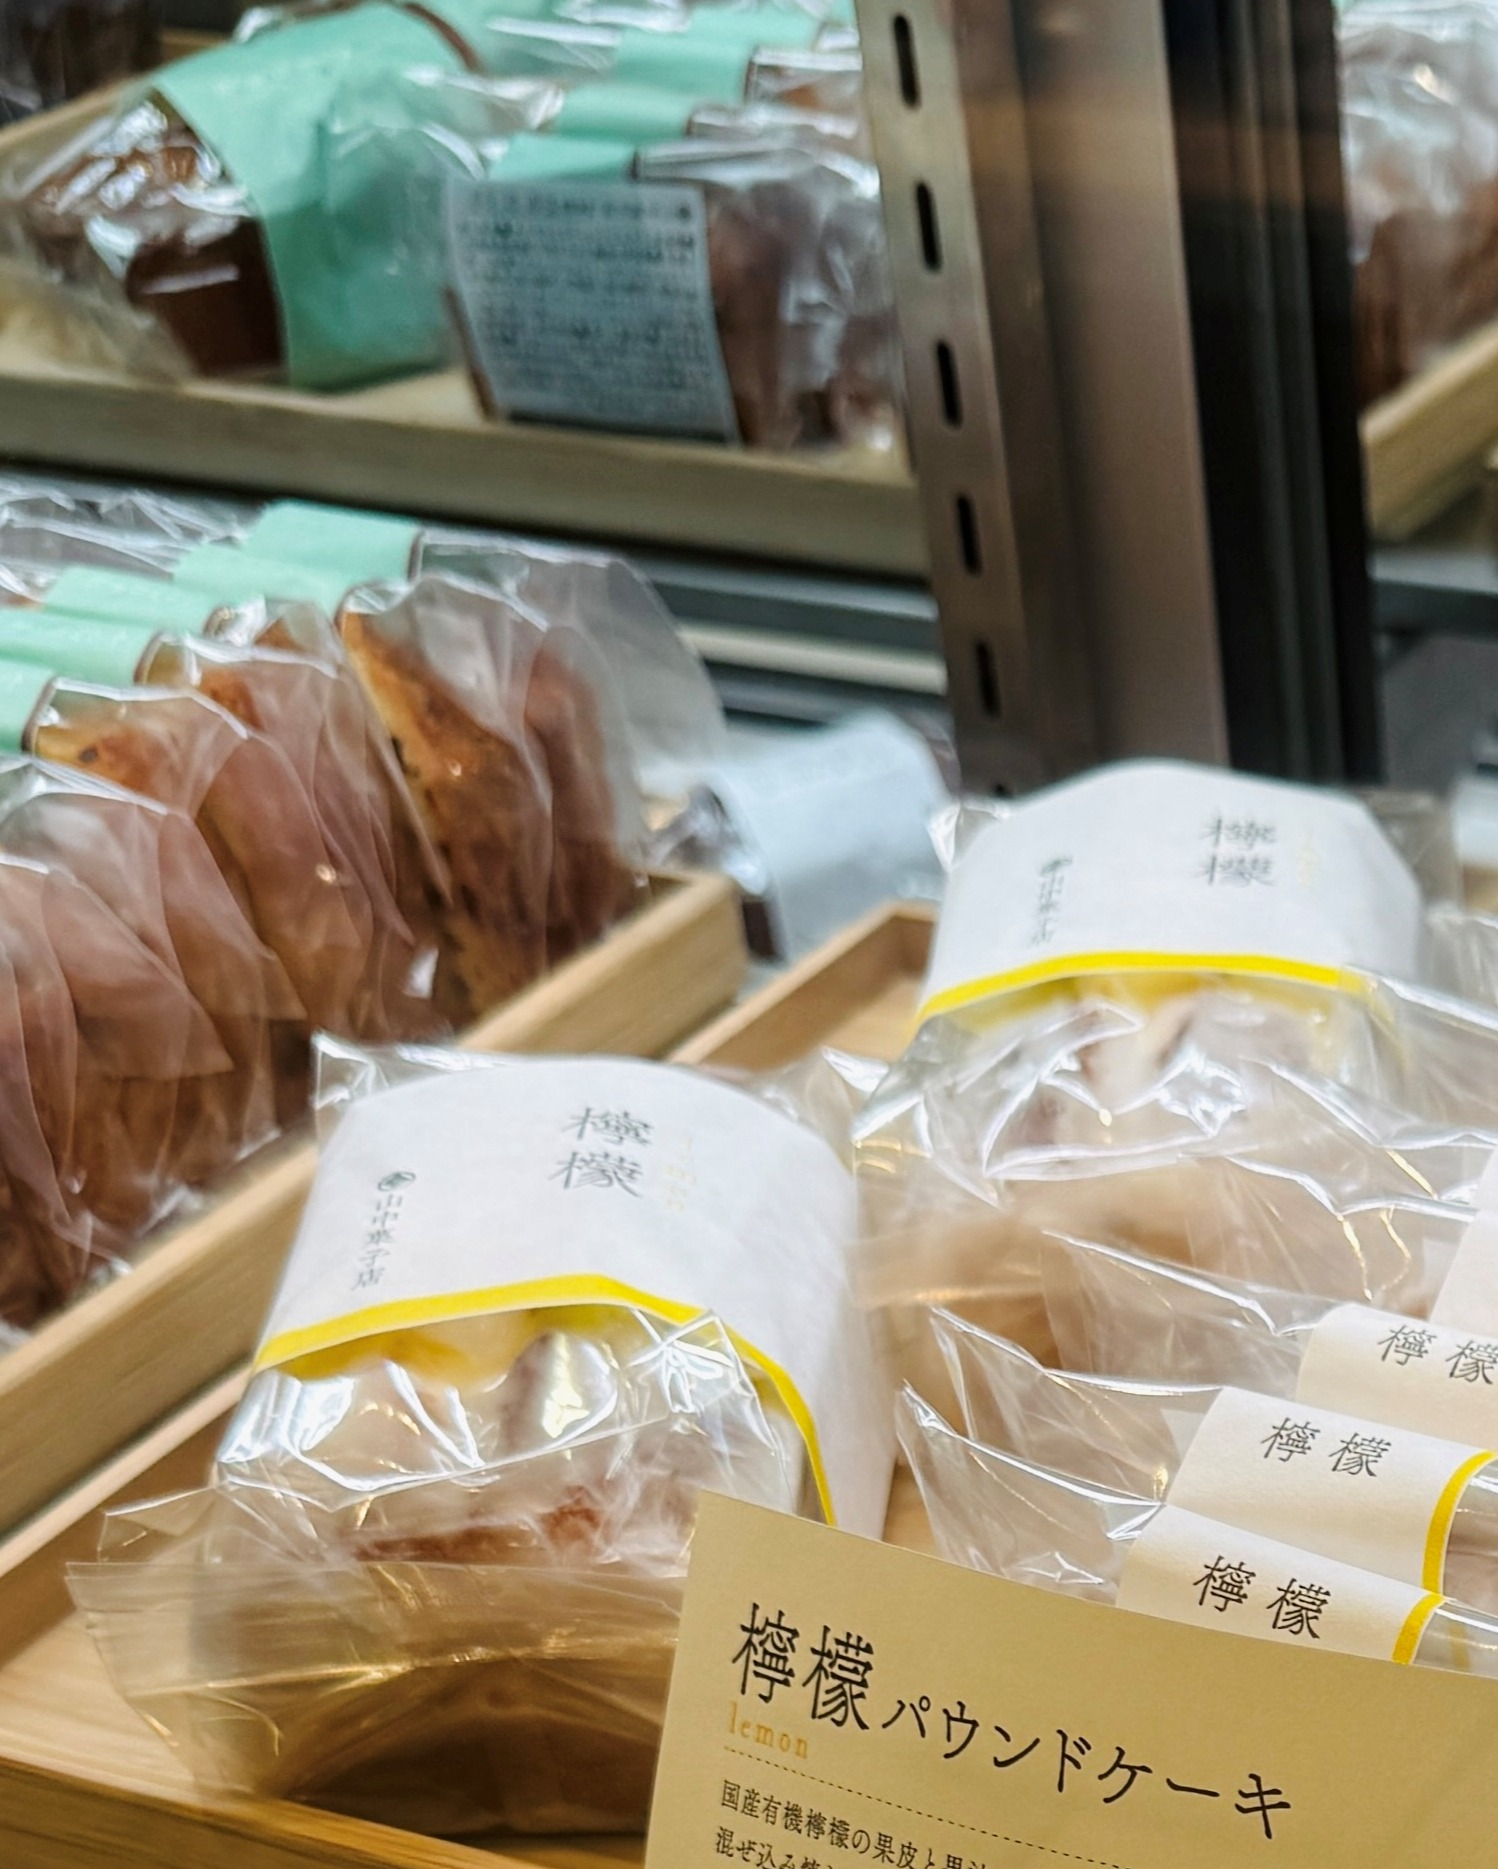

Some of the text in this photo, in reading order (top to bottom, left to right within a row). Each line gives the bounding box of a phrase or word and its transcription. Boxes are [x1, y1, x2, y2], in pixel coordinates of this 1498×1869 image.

[1259, 1416, 1392, 1479] 檸檬
[1192, 1553, 1332, 1641] 檸檬
[728, 1702, 810, 1762] lemon
[731, 1601, 1292, 1840] 檸檬パウンドケーキ
